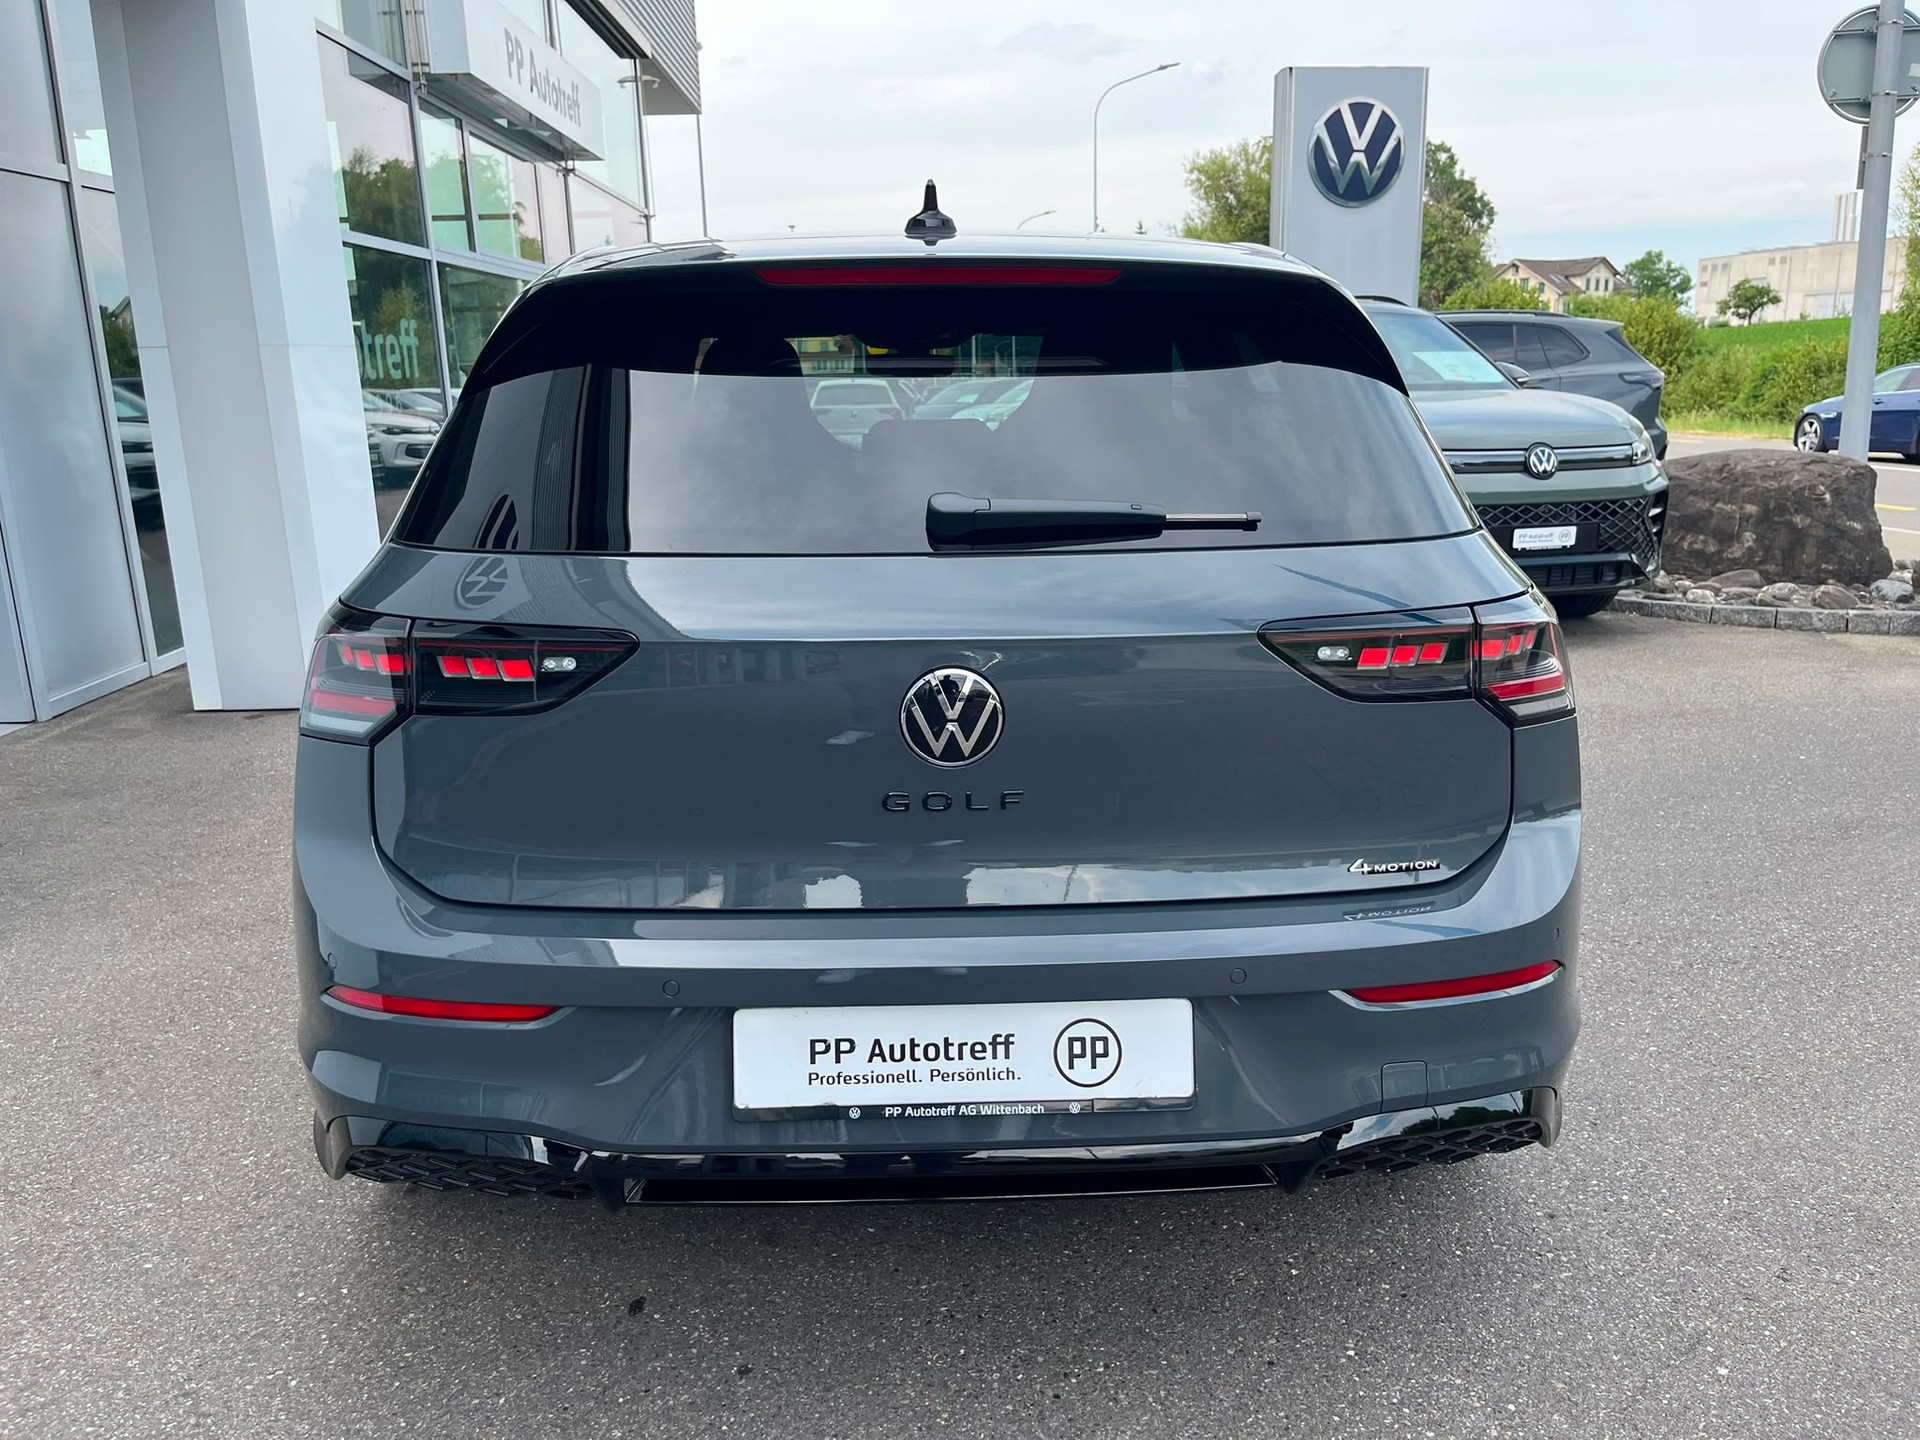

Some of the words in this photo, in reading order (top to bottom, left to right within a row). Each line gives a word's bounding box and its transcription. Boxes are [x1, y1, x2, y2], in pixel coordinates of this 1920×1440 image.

[504, 27, 524, 85] PP
[529, 48, 581, 127] Autotreff
[1310, 97, 1404, 206] VW
[1529, 447, 1557, 475] VW
[902, 668, 1003, 766] VW
[881, 790, 1024, 812] GOLF
[1347, 859, 1439, 875] 4MOTION
[809, 1038, 856, 1065] PP
[867, 1033, 1015, 1063] Autotreff
[1067, 1036, 1109, 1070] PP
[808, 1070, 923, 1086] Professionell.
[930, 1067, 1022, 1083] Persönlich.
[885, 1107, 901, 1117] PP
[905, 1105, 956, 1117] Autotreff
[959, 1105, 977, 1115] AG
[980, 1103, 1045, 1115] Wittenbach
